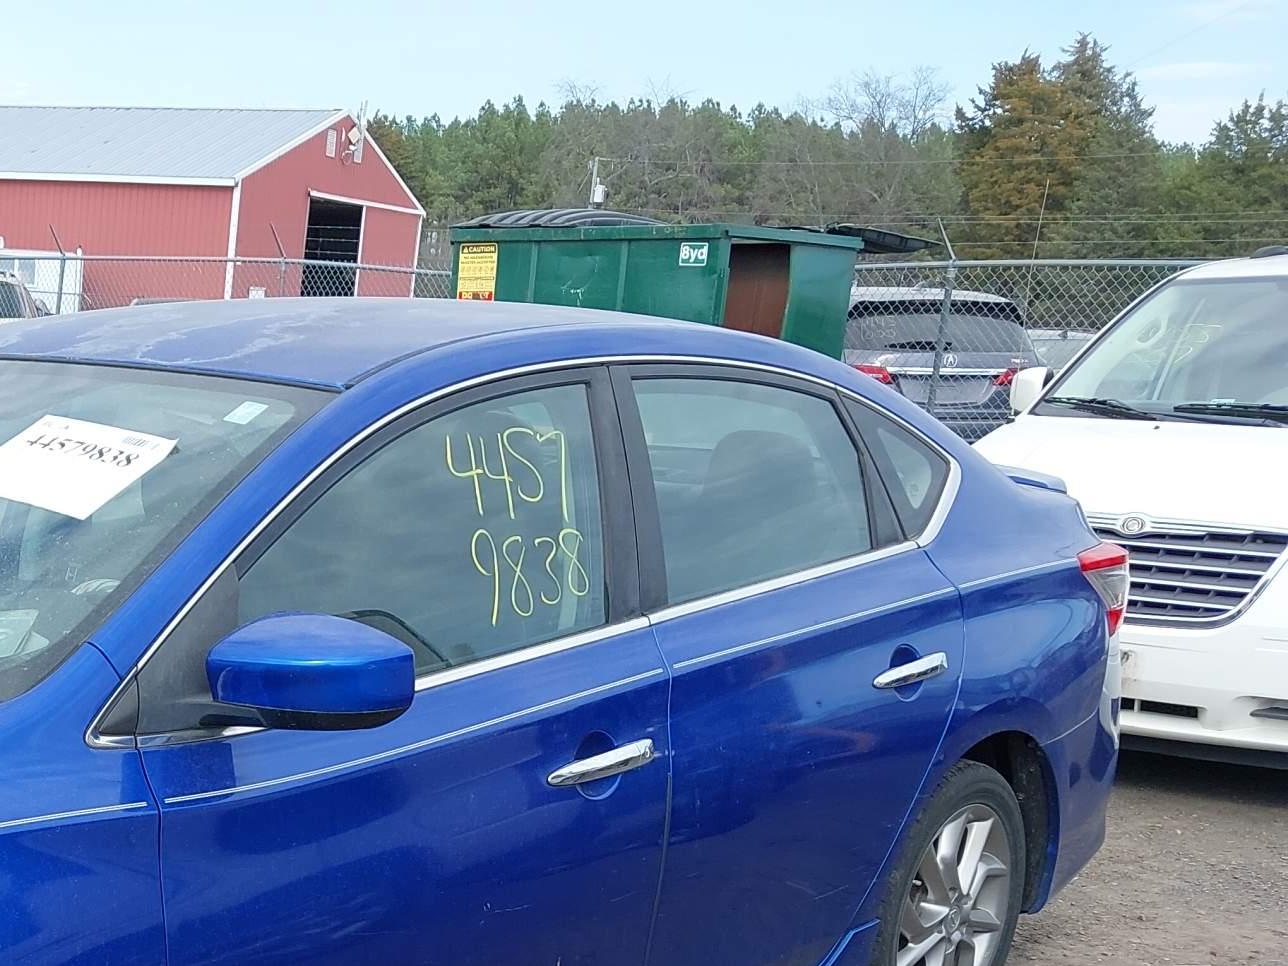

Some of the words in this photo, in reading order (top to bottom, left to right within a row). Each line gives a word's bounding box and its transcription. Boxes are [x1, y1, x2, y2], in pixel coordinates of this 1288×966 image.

[681, 245, 709, 263] 8yd
[25, 433, 141, 468] 44579838
[446, 427, 569, 522] 4457
[471, 528, 589, 627] 9838
